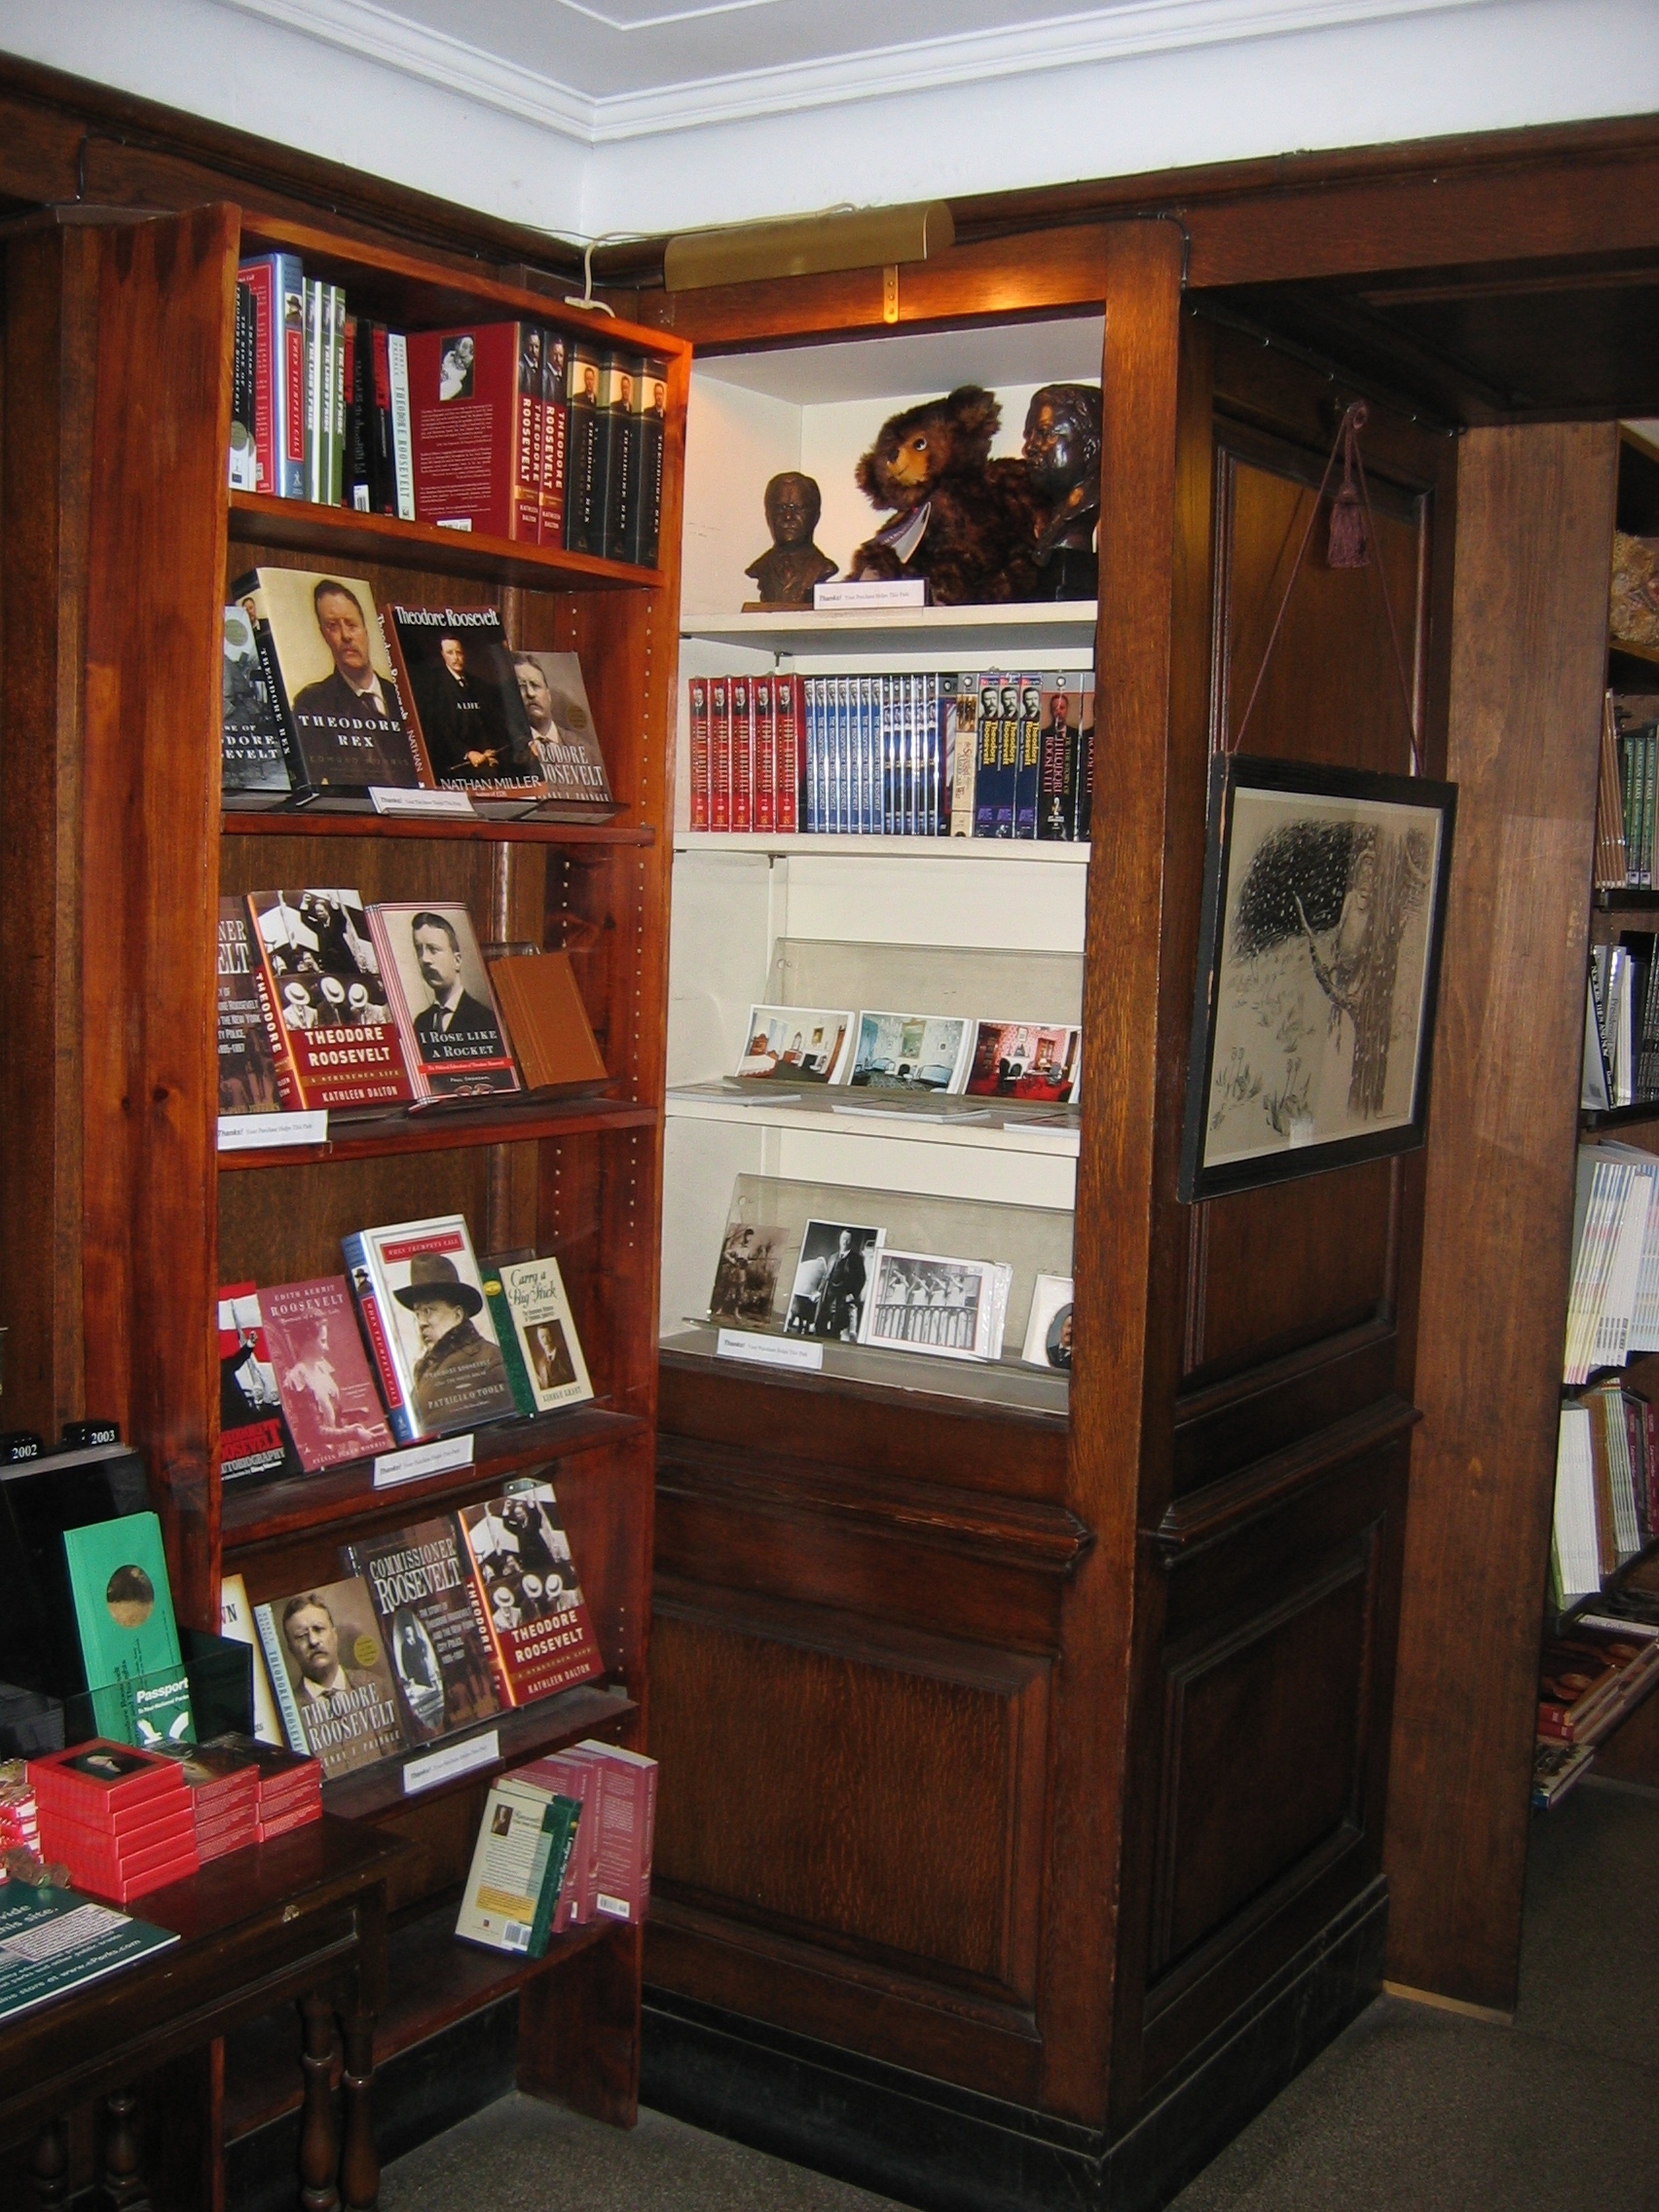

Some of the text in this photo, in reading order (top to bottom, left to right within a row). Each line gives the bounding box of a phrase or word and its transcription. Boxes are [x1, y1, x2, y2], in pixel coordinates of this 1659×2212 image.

[395, 386, 410, 498] THEODORE ROOSEVELT
[521, 397, 532, 482] ROOSEVELT
[533, 404, 541, 482] THEODORE
[543, 405, 555, 490] ROOSEVELT
[556, 412, 565, 489] THEODORE
[394, 605, 500, 628] Theodore Roosevelt
[260, 647, 291, 756] THEODORE REX
[298, 715, 401, 732] THEODORE
[222, 735, 278, 746] DORE
[337, 734, 375, 749] REX
[406, 728, 423, 773] NATHAN
[222, 749, 278, 759] EVELT
[537, 743, 588, 764] EODORE
[439, 775, 543, 792] NATHAN MILLER
[541, 763, 604, 787] OSEVELT
[255, 972, 282, 1053] THEODORE
[305, 1026, 385, 1047] THEODORE
[420, 1032, 426, 1044] I
[308, 1047, 391, 1067] ROOSEVELT
[322, 1086, 399, 1102] KATHLEEN DALTON
[387, 1237, 460, 1257] WHEN TRUMPETS CALL
[510, 1269, 547, 1288] Carry a
[270, 1294, 345, 1317] ROOSEVELT
[274, 1284, 337, 1302] EDITH KERMIT
[91, 1429, 116, 1445] 2003
[12, 1444, 38, 1459] 2002
[369, 1537, 457, 1580] COMMISSIONER
[373, 1557, 462, 1615] ROOSEVELT
[464, 1580, 494, 1654] THEODORE
[511, 1609, 578, 1643] THEODORE
[515, 1627, 584, 1663] ROOSEVELT
[268, 1650, 290, 1703] THEODORE
[527, 1663, 592, 1695] KATHLEEN DALTON
[136, 1677, 190, 1704] Passport
[301, 1681, 381, 1726] THEODORE
[309, 1699, 396, 1751] ROOSEVELT
[0, 1903, 32, 1920] vide
[0, 1920, 23, 1935] his
[24, 1907, 58, 1923] site.
